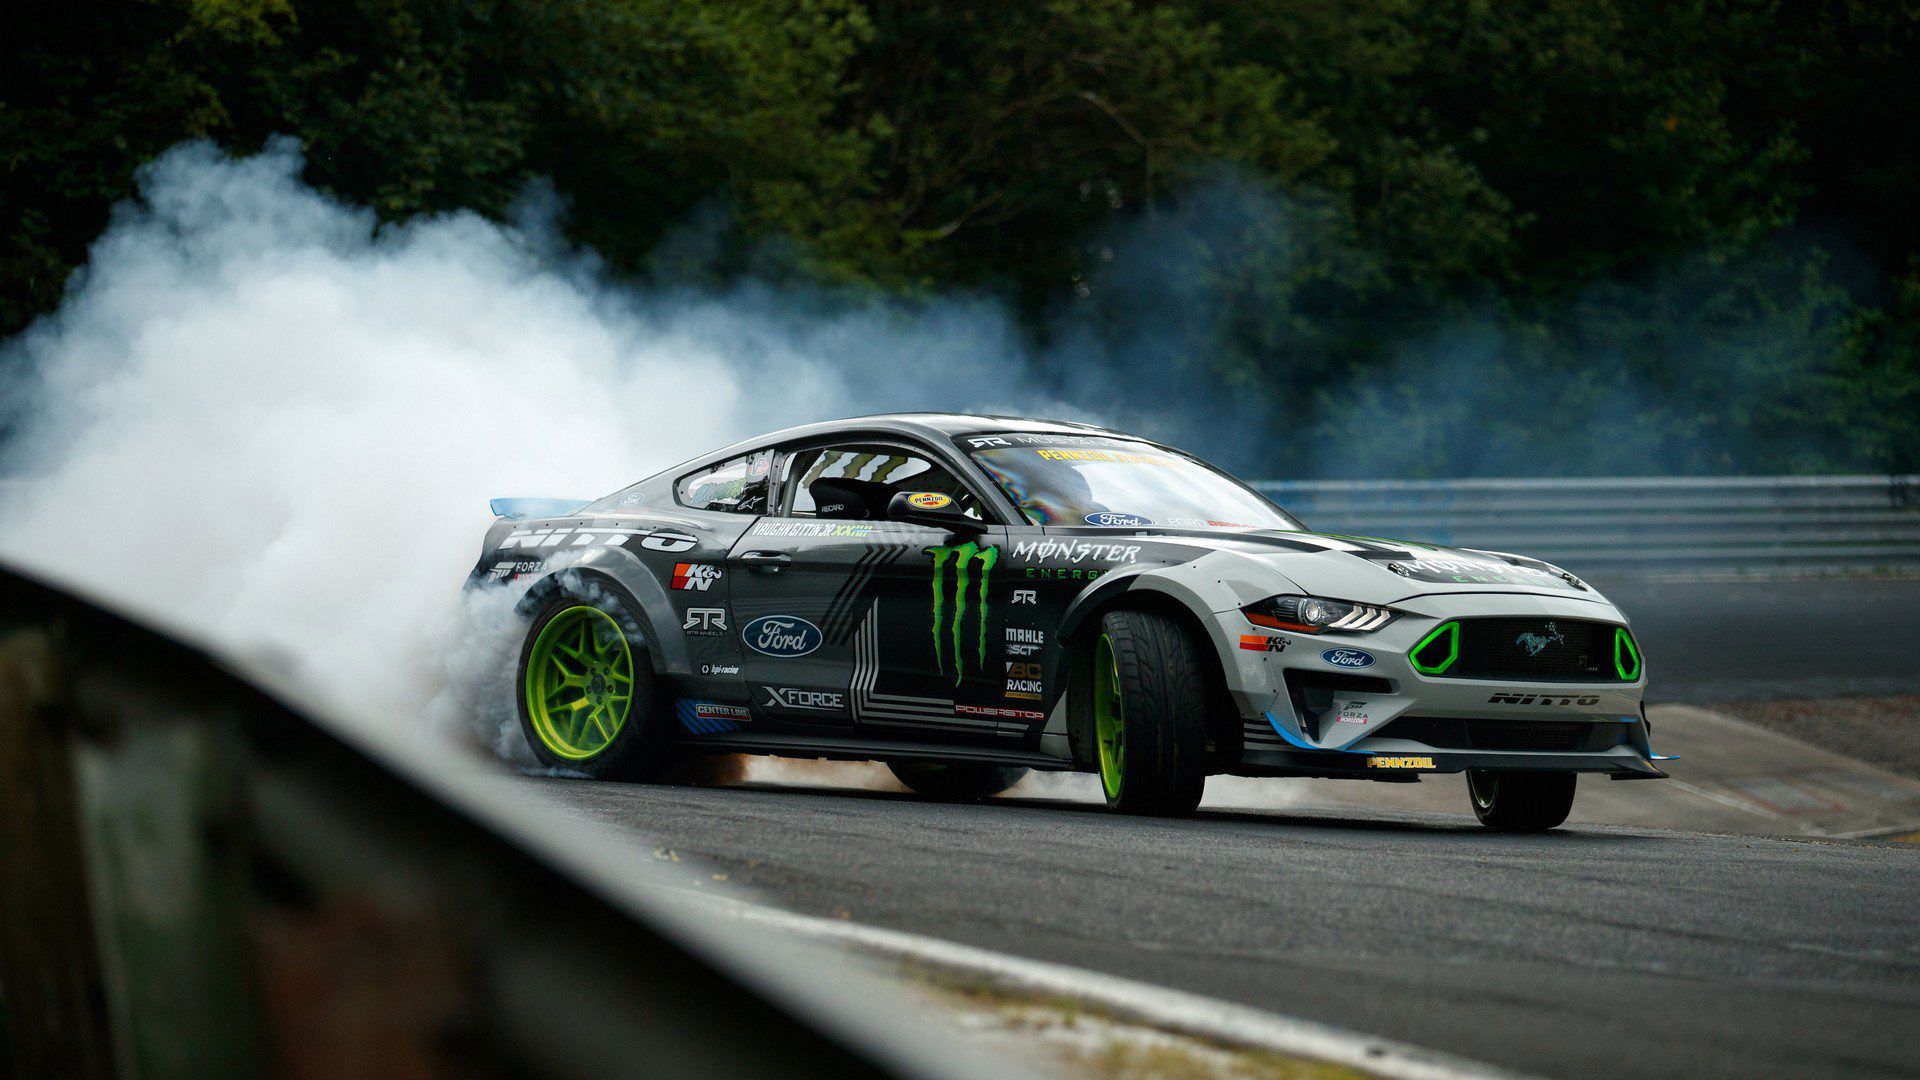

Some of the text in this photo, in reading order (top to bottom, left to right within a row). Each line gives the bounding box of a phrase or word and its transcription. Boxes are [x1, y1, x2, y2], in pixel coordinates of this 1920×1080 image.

[821, 504, 845, 513] RECARO
[1100, 513, 1143, 526] Ford
[498, 528, 699, 553] NITTO
[515, 561, 548, 572] FORZA
[683, 607, 727, 631] RTR
[757, 620, 808, 651] Ford
[1006, 628, 1044, 643] MAHLE
[1330, 650, 1365, 667] Ford
[1006, 661, 1042, 680] BC
[1006, 679, 1042, 693] RACING
[761, 685, 846, 710] XFORCE
[1487, 693, 1600, 706] NITTO
[697, 705, 751, 718] CENTER LINE
[1367, 756, 1437, 769] PENNZOIL
